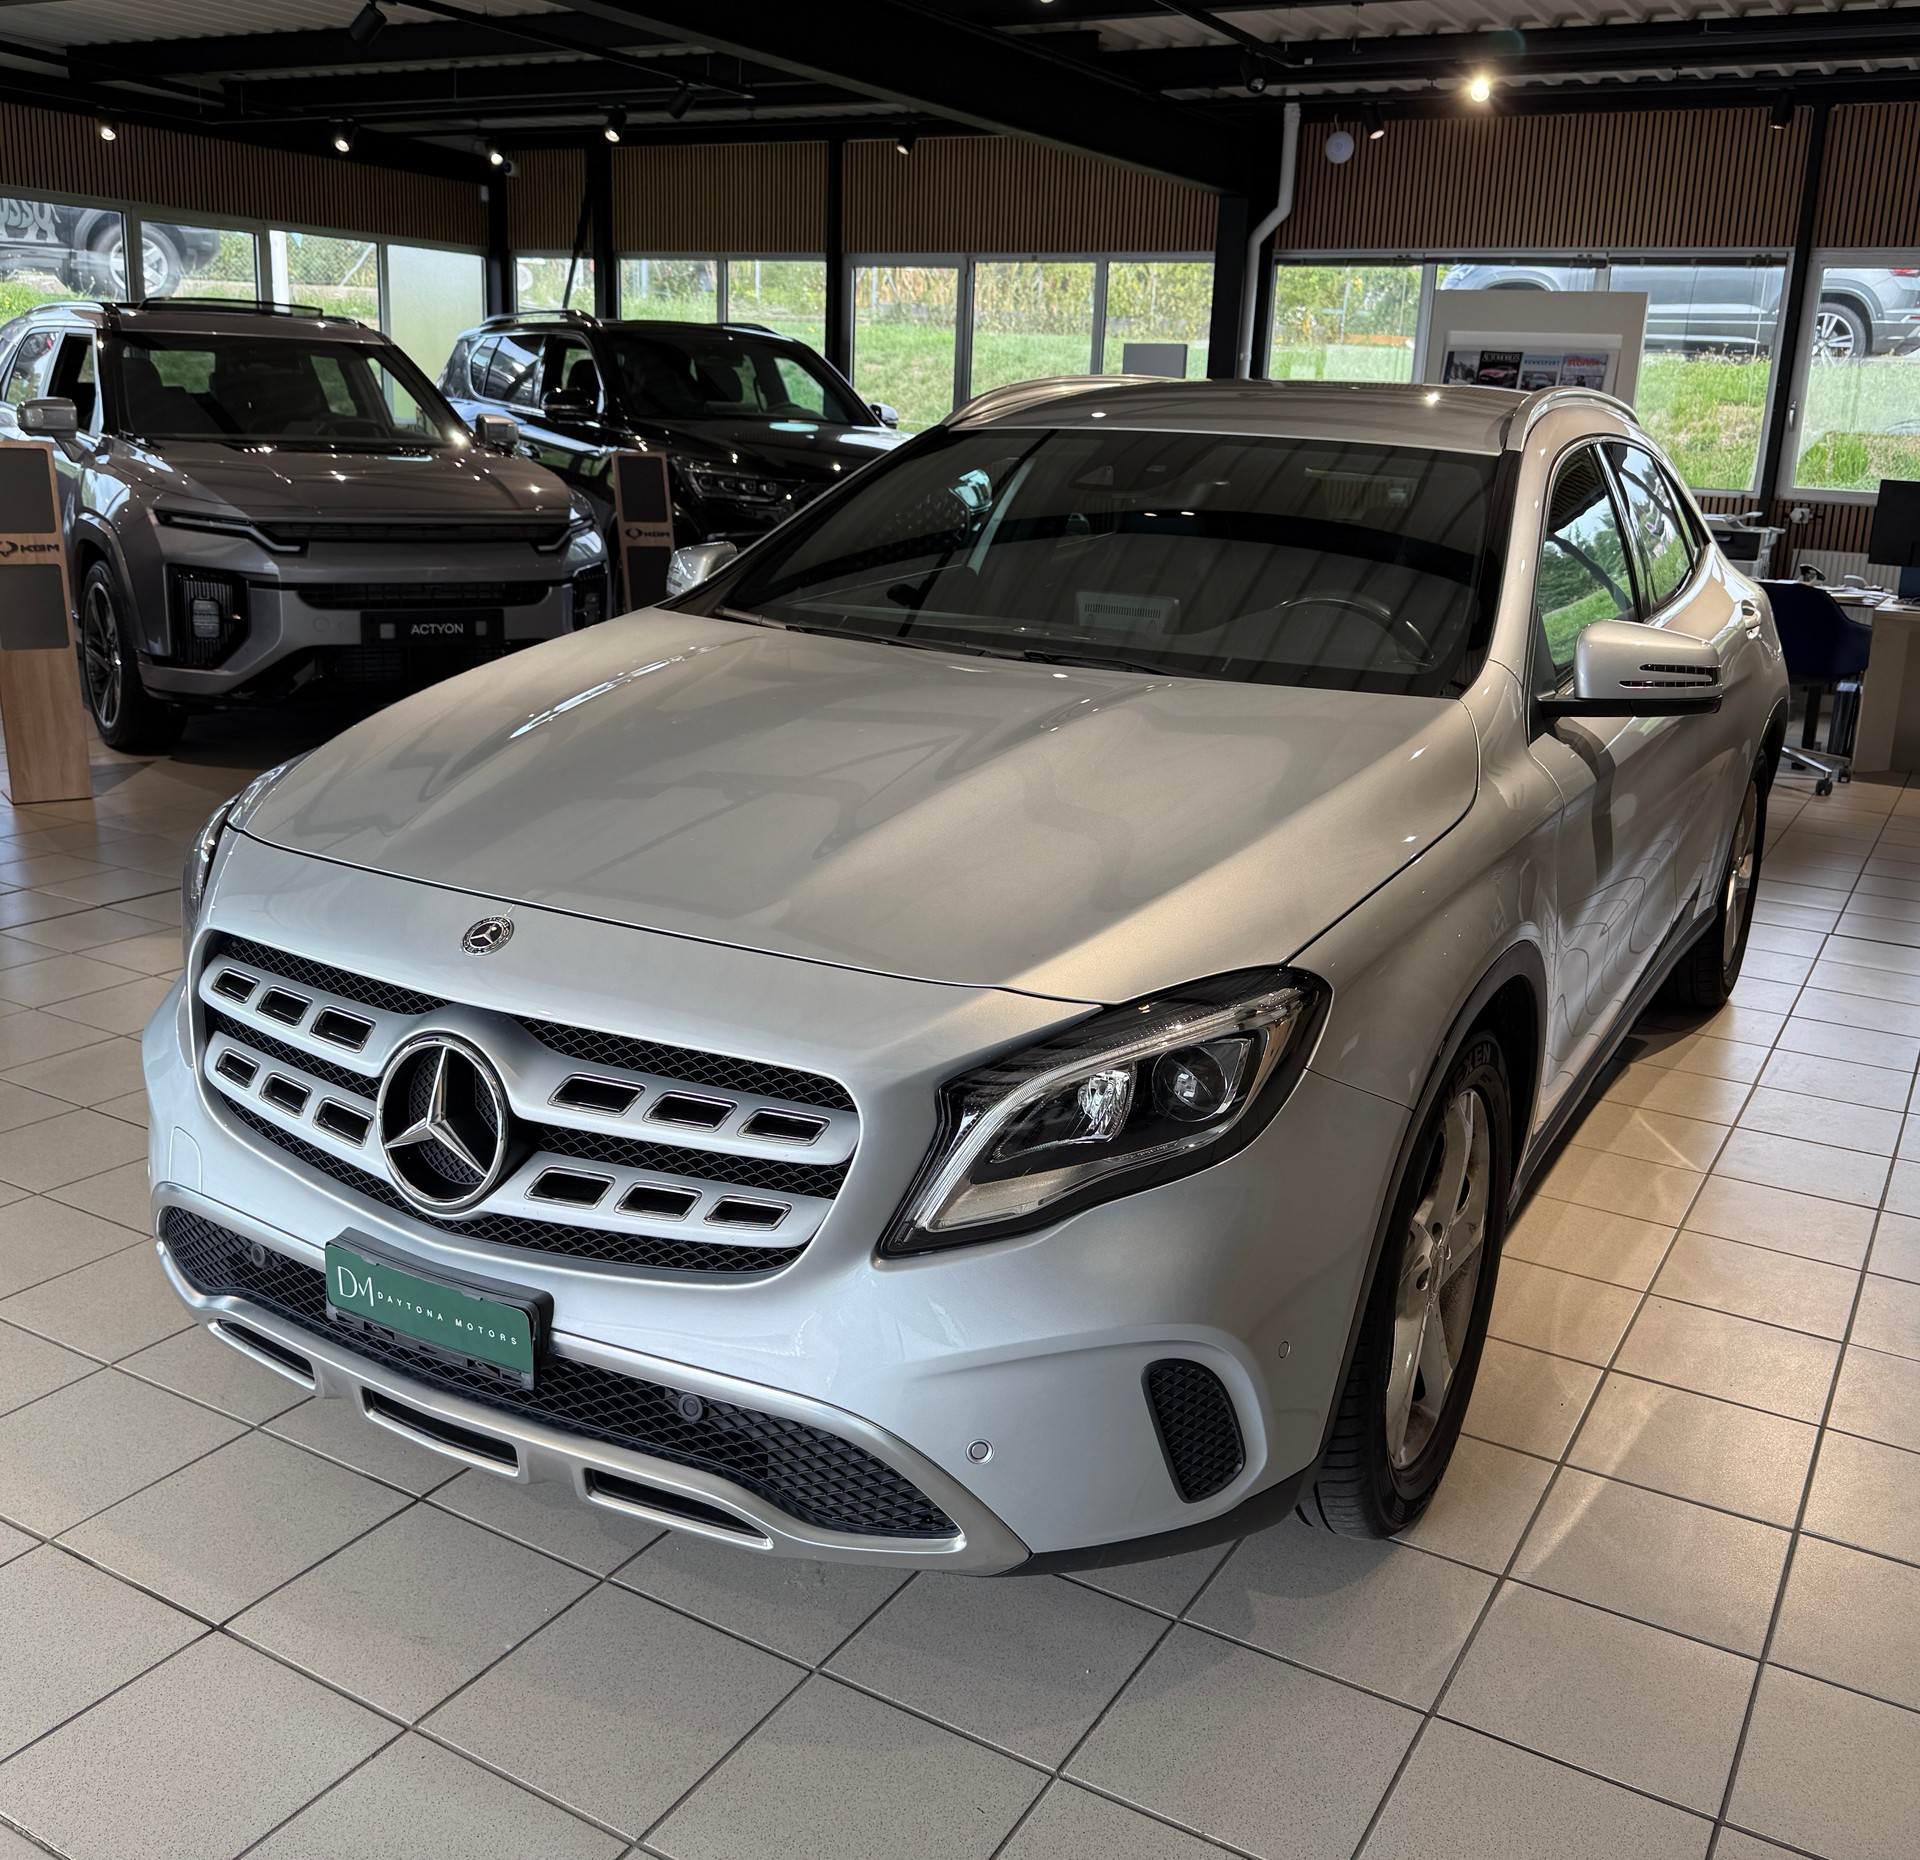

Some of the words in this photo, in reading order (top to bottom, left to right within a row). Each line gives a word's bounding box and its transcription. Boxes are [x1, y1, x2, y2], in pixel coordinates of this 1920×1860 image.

[20, 544, 60, 553] KGM
[411, 623, 464, 635] ACTYON
[377, 1291, 444, 1322] DAYTONA
[455, 1318, 518, 1346] MOTORS
